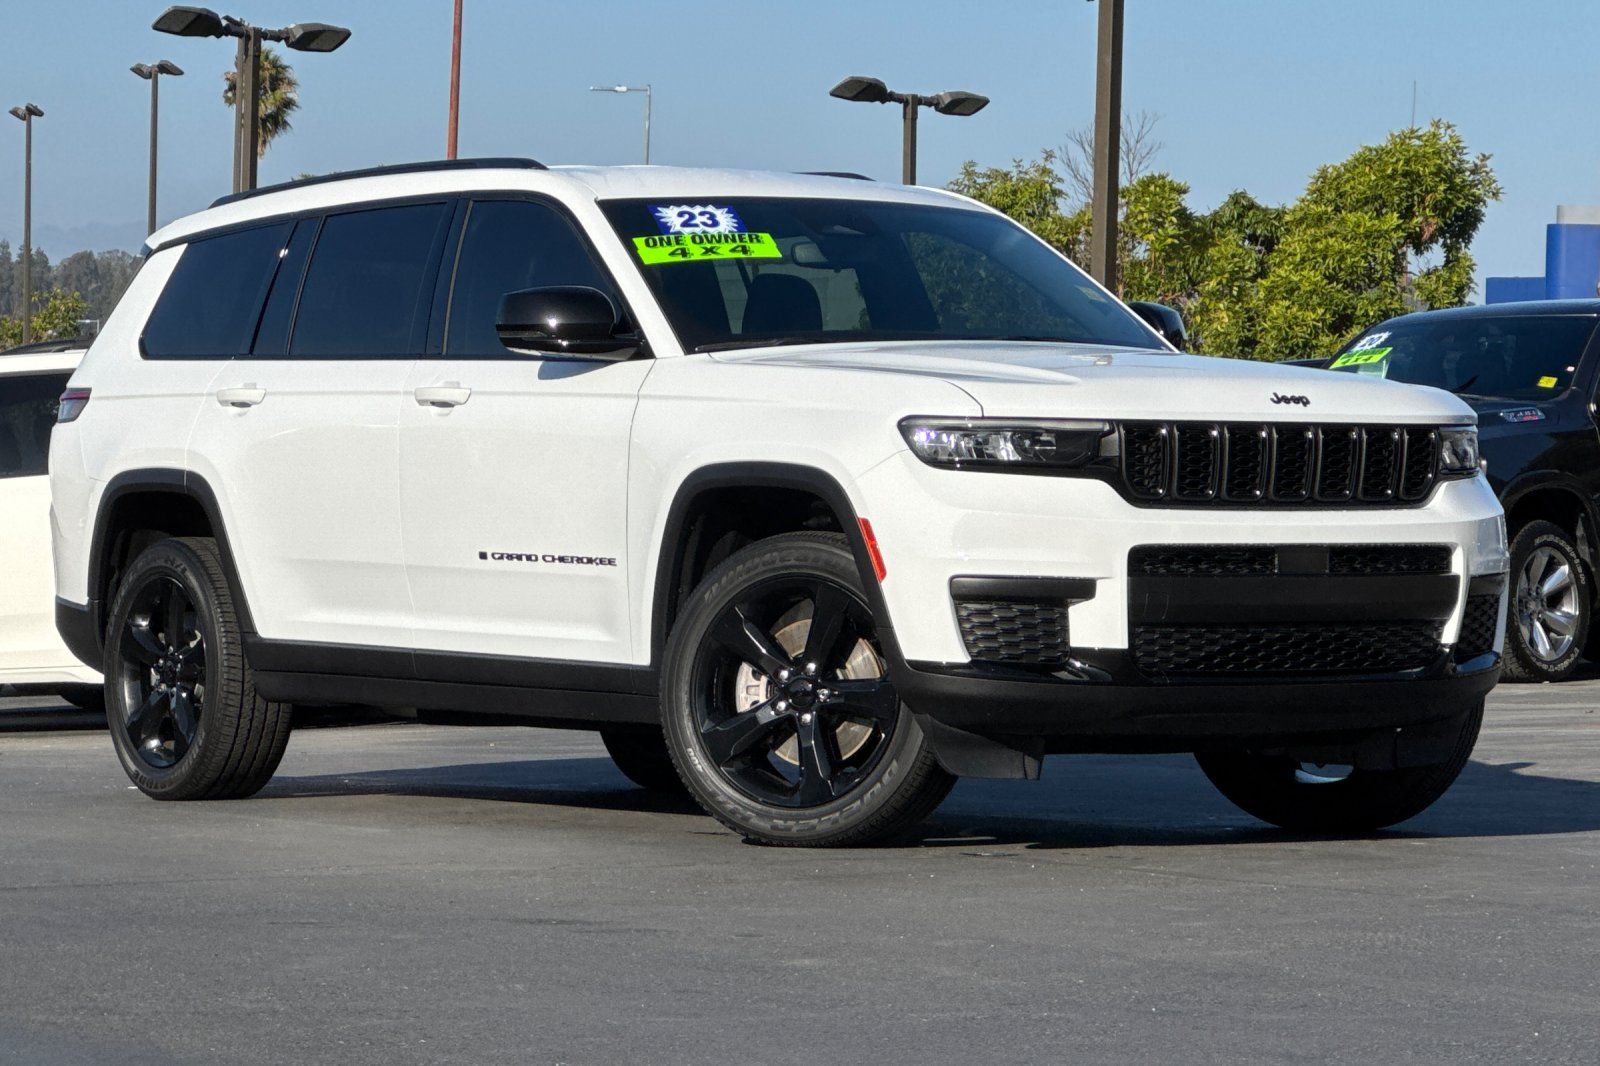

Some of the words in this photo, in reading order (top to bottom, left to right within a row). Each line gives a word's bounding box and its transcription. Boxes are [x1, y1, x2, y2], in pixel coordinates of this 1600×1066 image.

[677, 211, 720, 228] 23
[644, 235, 685, 248] ONE
[691, 233, 761, 245] OWNER
[1270, 392, 1311, 407] Jeep
[491, 552, 538, 562] GRAND
[542, 554, 617, 566] CHEROKEE
